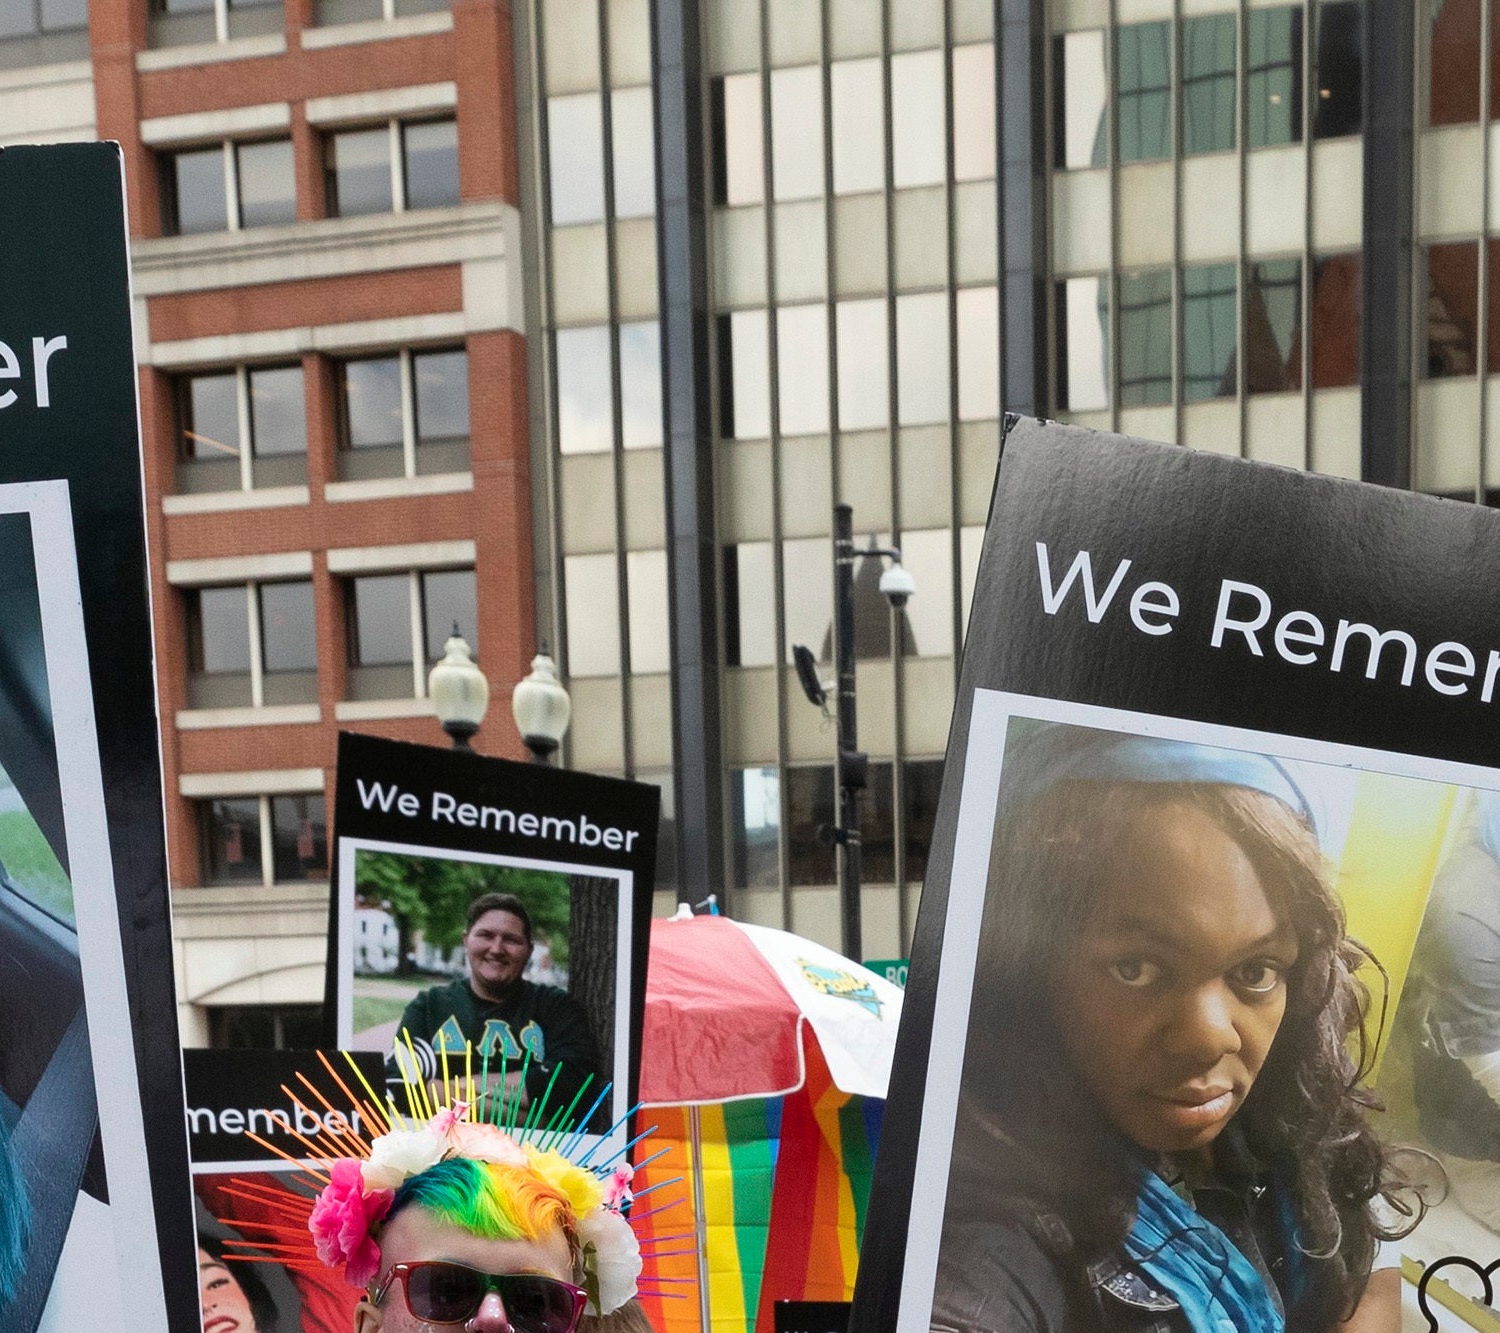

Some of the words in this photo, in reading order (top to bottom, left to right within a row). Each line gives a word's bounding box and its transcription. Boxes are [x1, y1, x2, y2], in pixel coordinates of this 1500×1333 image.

[1034, 540, 1180, 637] We
[356, 777, 421, 820] We
[431, 789, 640, 854] Remember
[184, 1103, 364, 1136] member
